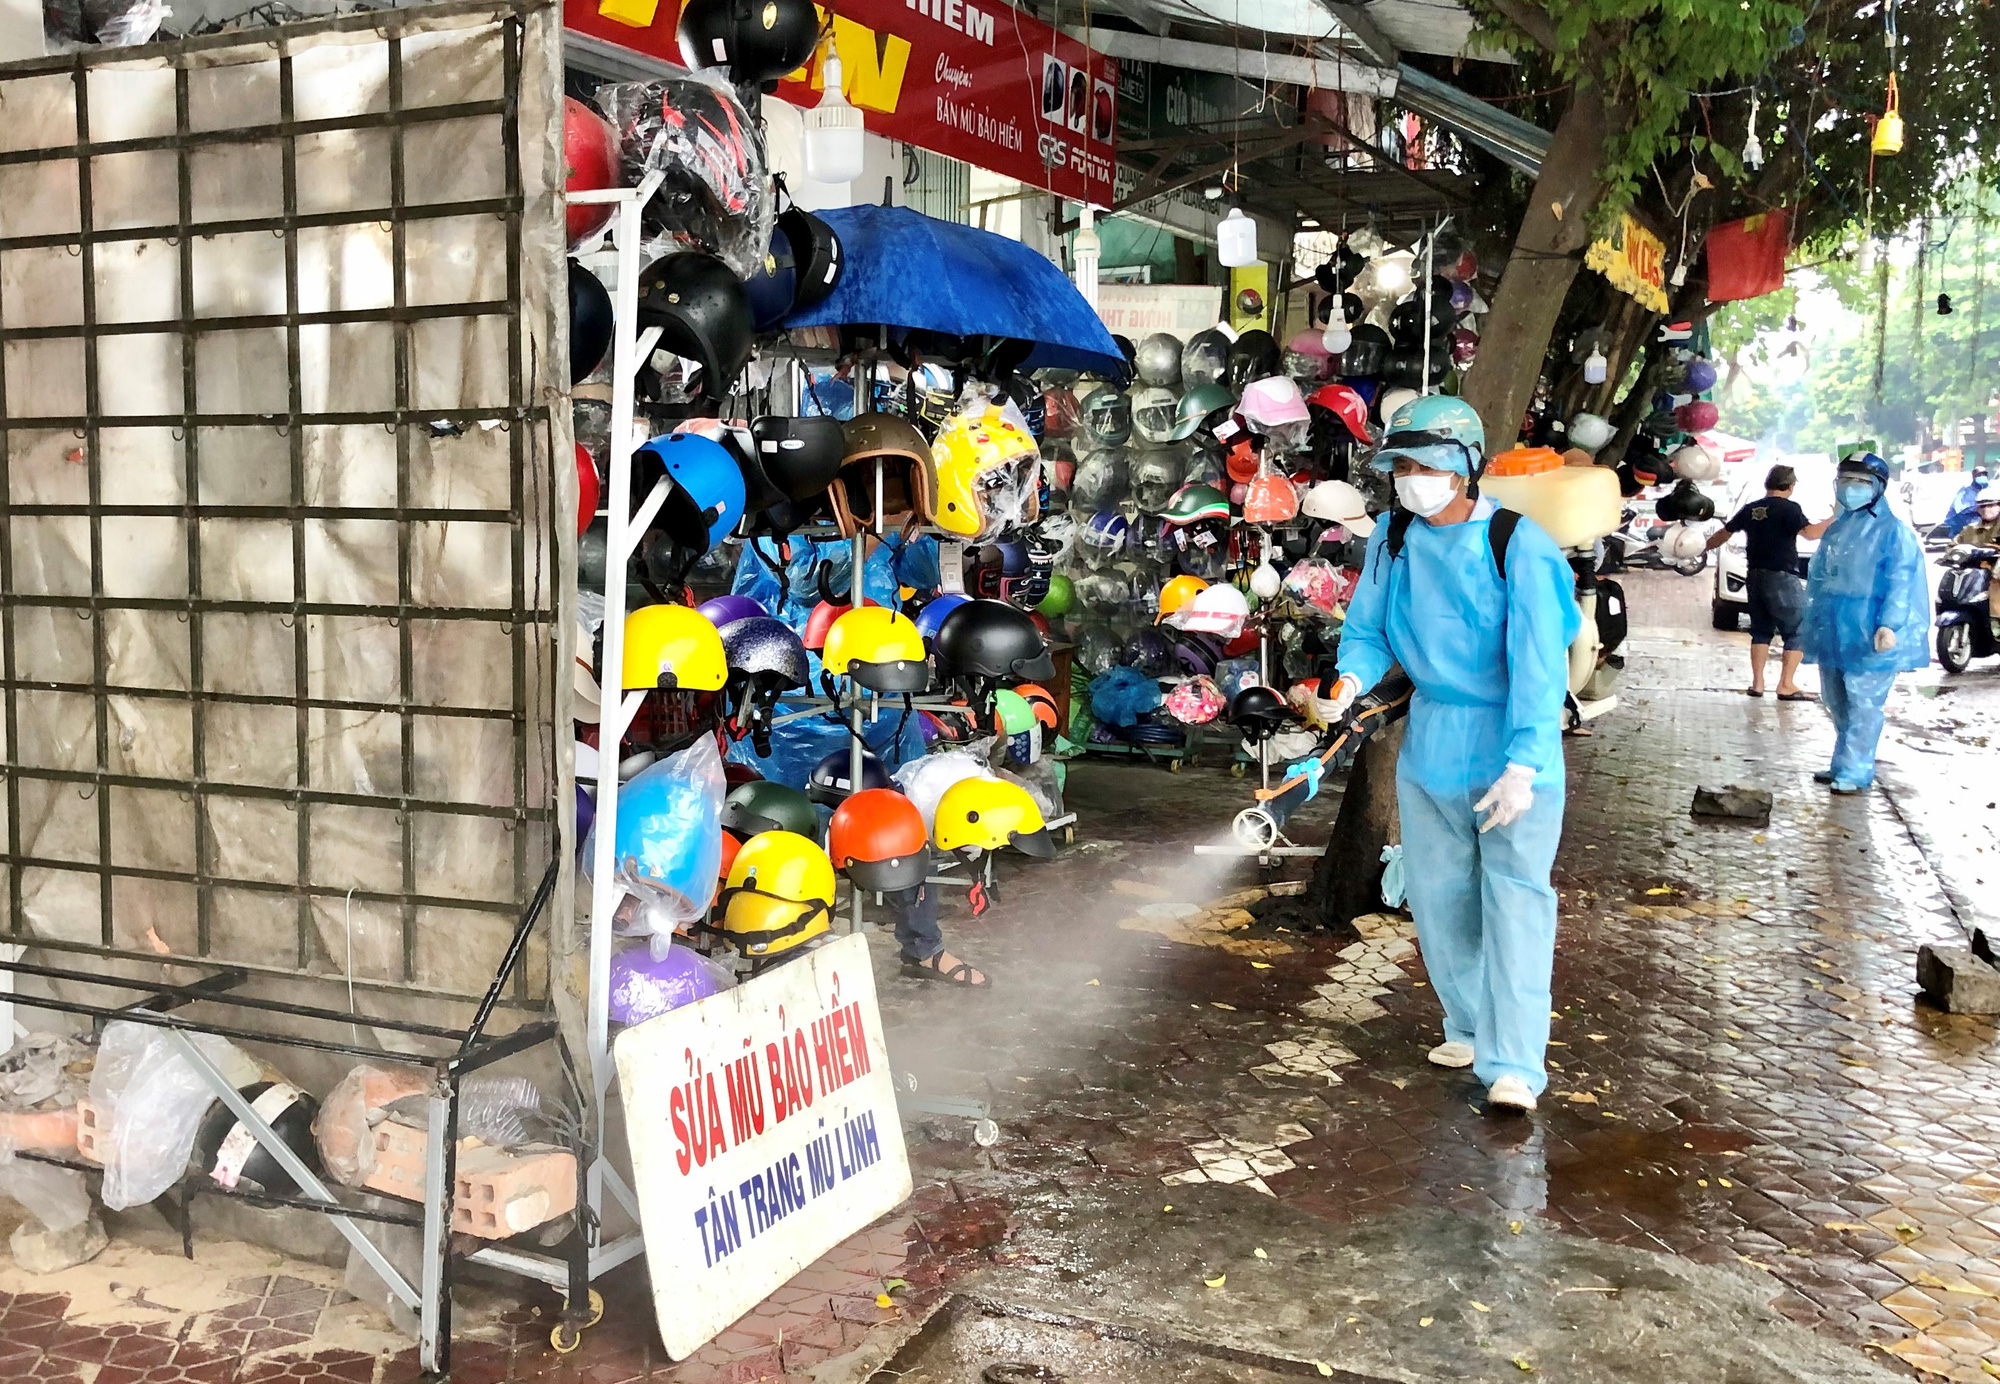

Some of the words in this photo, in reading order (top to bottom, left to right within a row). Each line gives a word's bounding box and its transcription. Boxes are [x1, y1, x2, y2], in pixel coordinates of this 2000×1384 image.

[936, 92, 958, 128] BÁN
[960, 102, 976, 135] MŨ
[978, 105, 997, 143] BẢO
[998, 116, 1022, 153] HIỂM
[1038, 133, 1067, 166] GRS
[670, 1047, 727, 1176] SỬA
[725, 1035, 765, 1146] MŨ
[766, 1004, 814, 1124] BẢO
[811, 971, 872, 1097] HIỂM
[694, 1186, 742, 1269] TÂN
[740, 1152, 805, 1240] TRANG
[805, 1115, 836, 1200] MŨ
[836, 1107, 882, 1181] LÍNH
